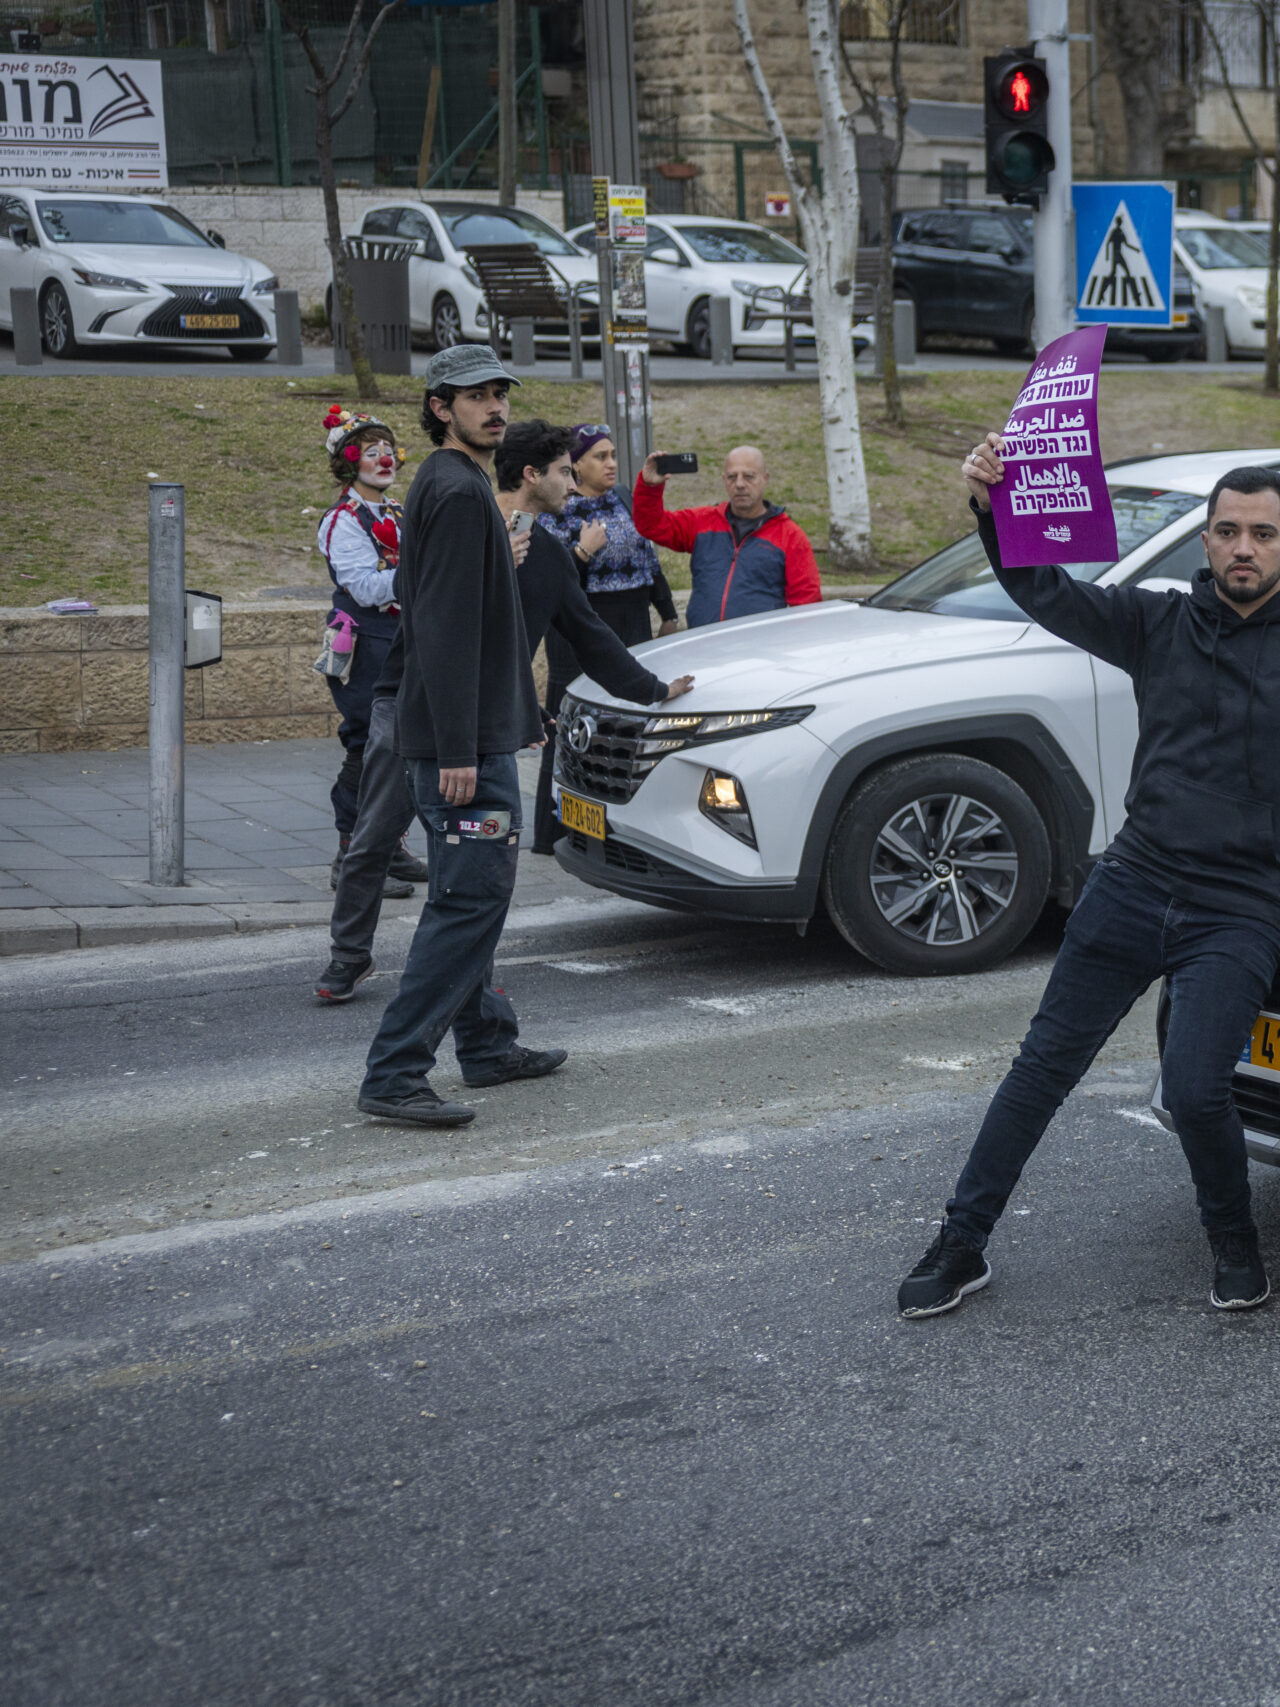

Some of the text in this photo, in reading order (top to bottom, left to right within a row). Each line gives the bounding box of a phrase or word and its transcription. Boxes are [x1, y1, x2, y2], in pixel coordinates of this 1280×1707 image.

[35, 61, 77, 75] הצלחה
[40, 127, 84, 139] סמינר
[0, 167, 47, 178] תעודת
[52, 168, 71, 178] עם
[1049, 355, 1077, 377] نقف
[1036, 379, 1090, 400] עומדות
[1059, 409, 1085, 429] ضد
[1062, 436, 1087, 453] נגד
[1015, 491, 1087, 514] וההפקרה
